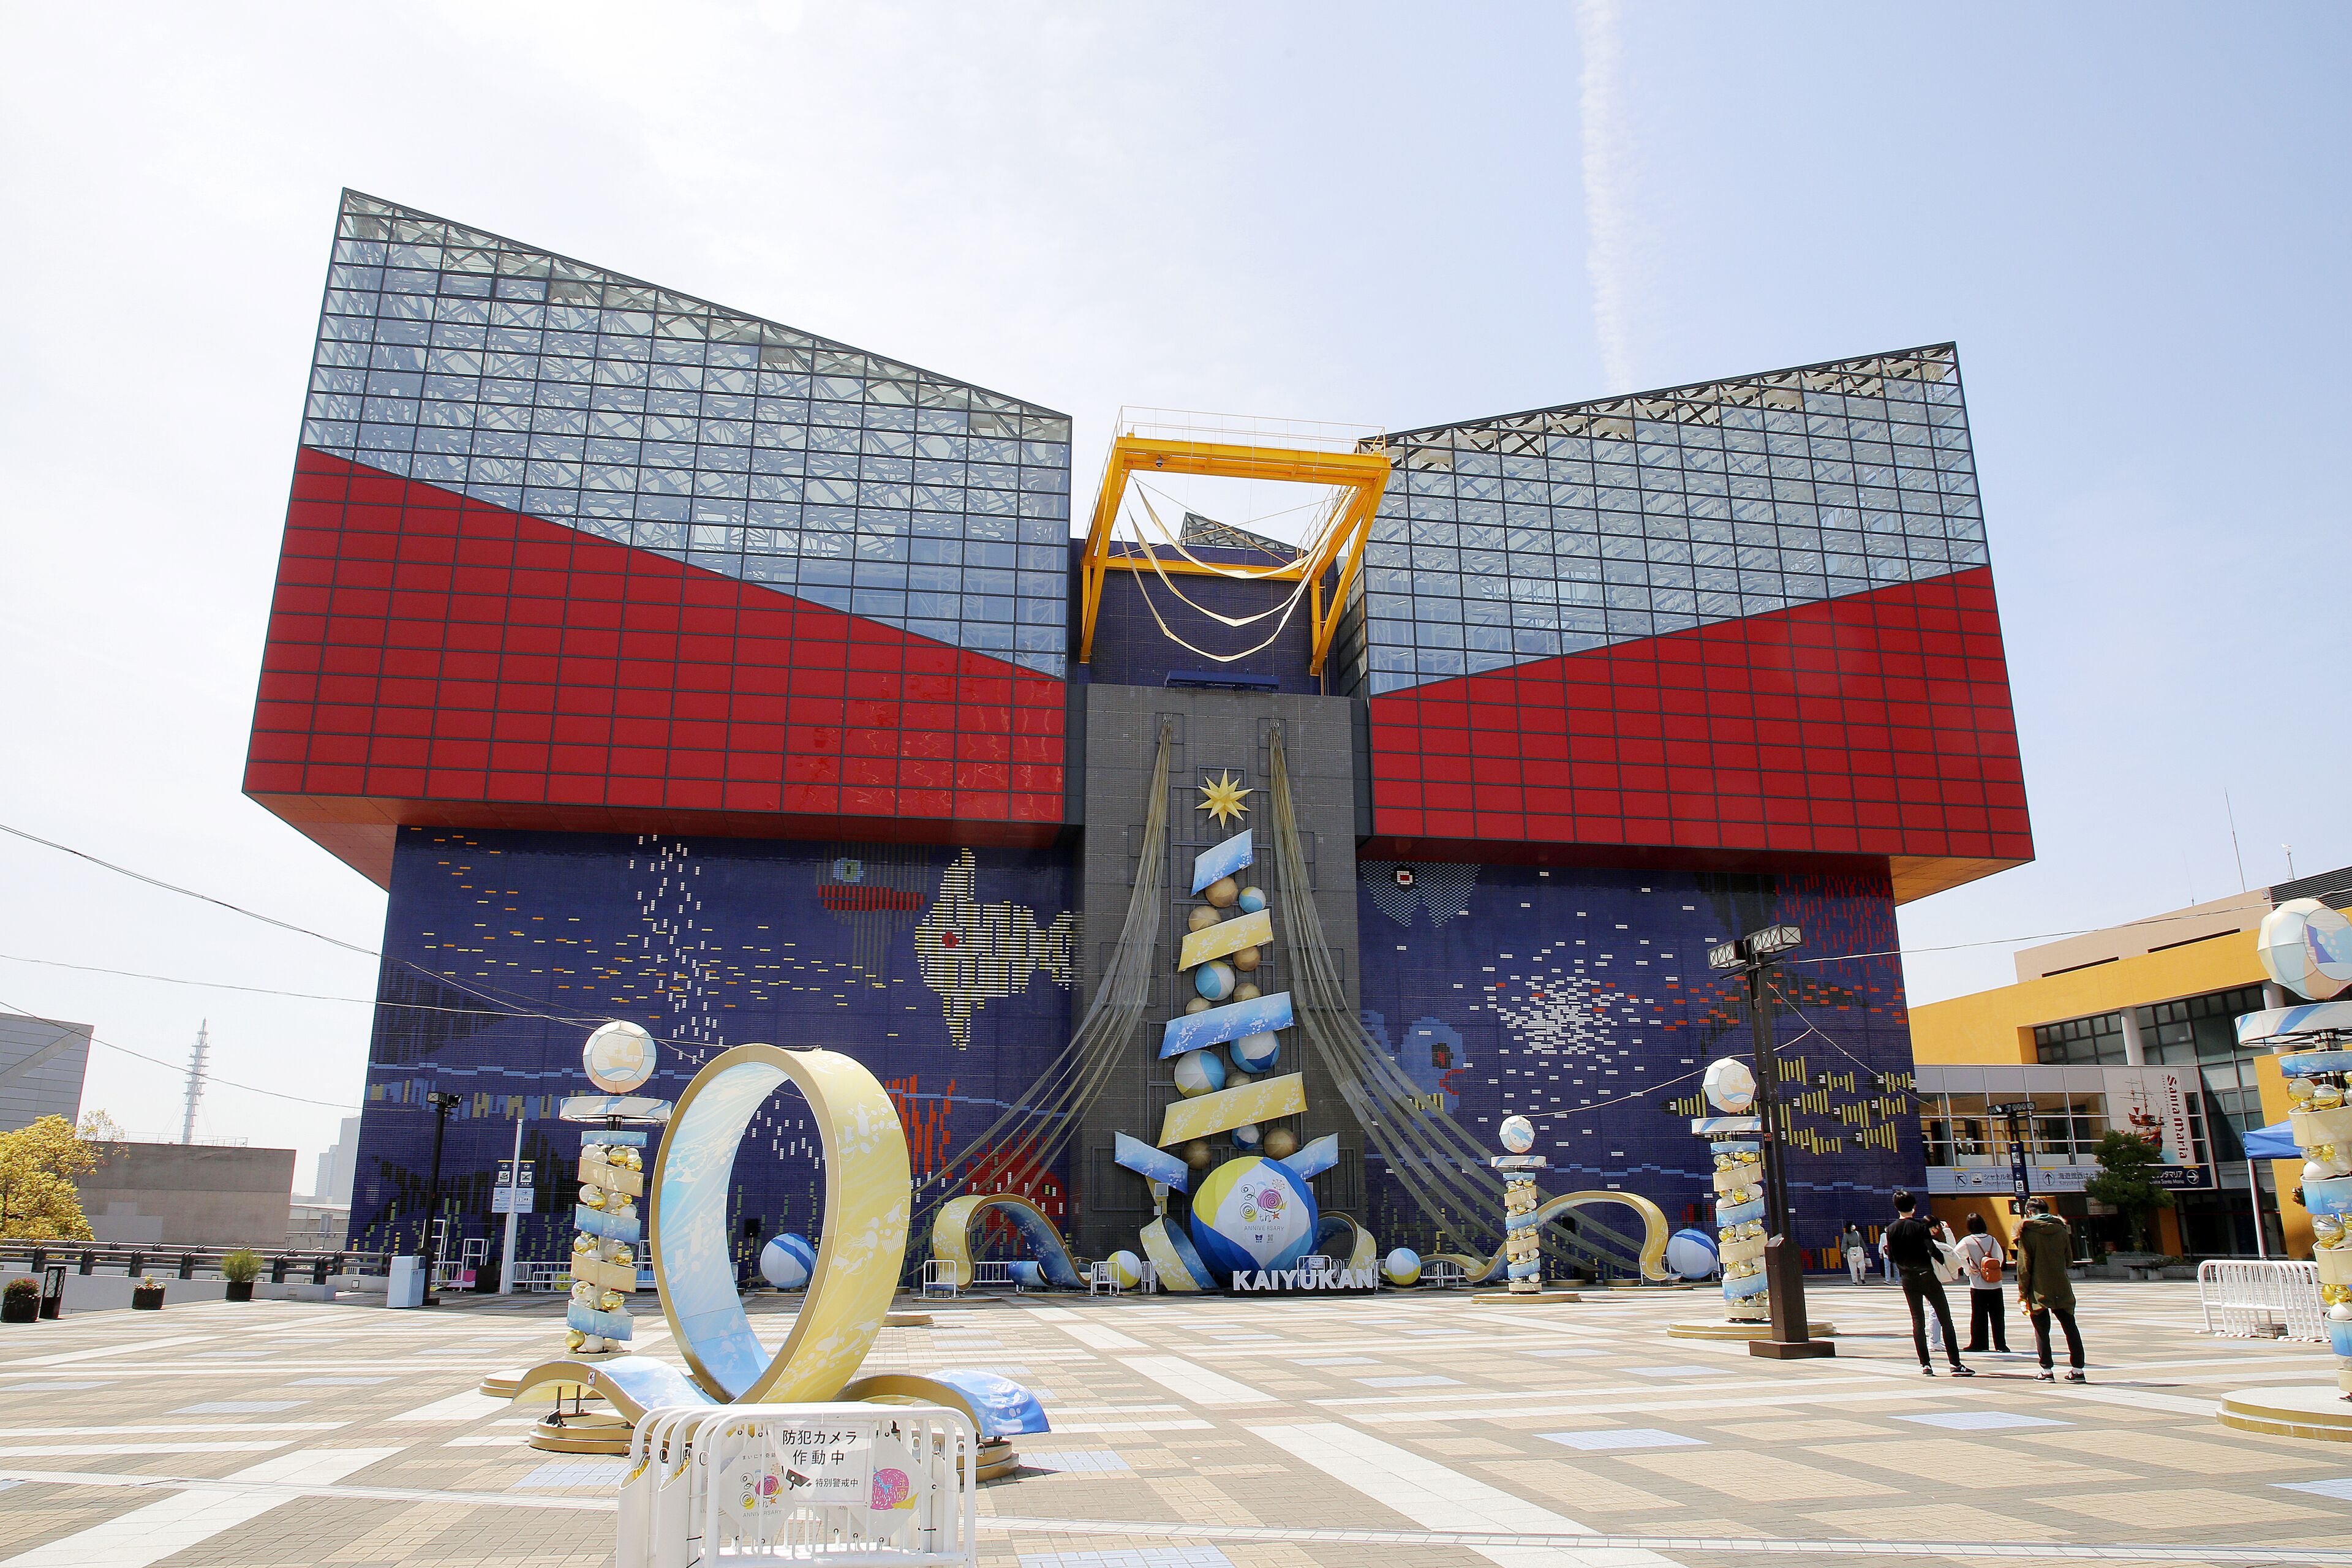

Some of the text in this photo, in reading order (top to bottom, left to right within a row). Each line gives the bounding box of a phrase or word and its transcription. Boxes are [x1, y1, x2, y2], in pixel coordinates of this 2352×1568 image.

[2167, 1074, 2188, 1159] Santa Maria
[1232, 1268, 1374, 1291] KAIYUKAN
[783, 1430, 857, 1445] 防犯カメラ
[793, 1449, 844, 1466] 作動中
[815, 1478, 858, 1488] 特別警戒中
